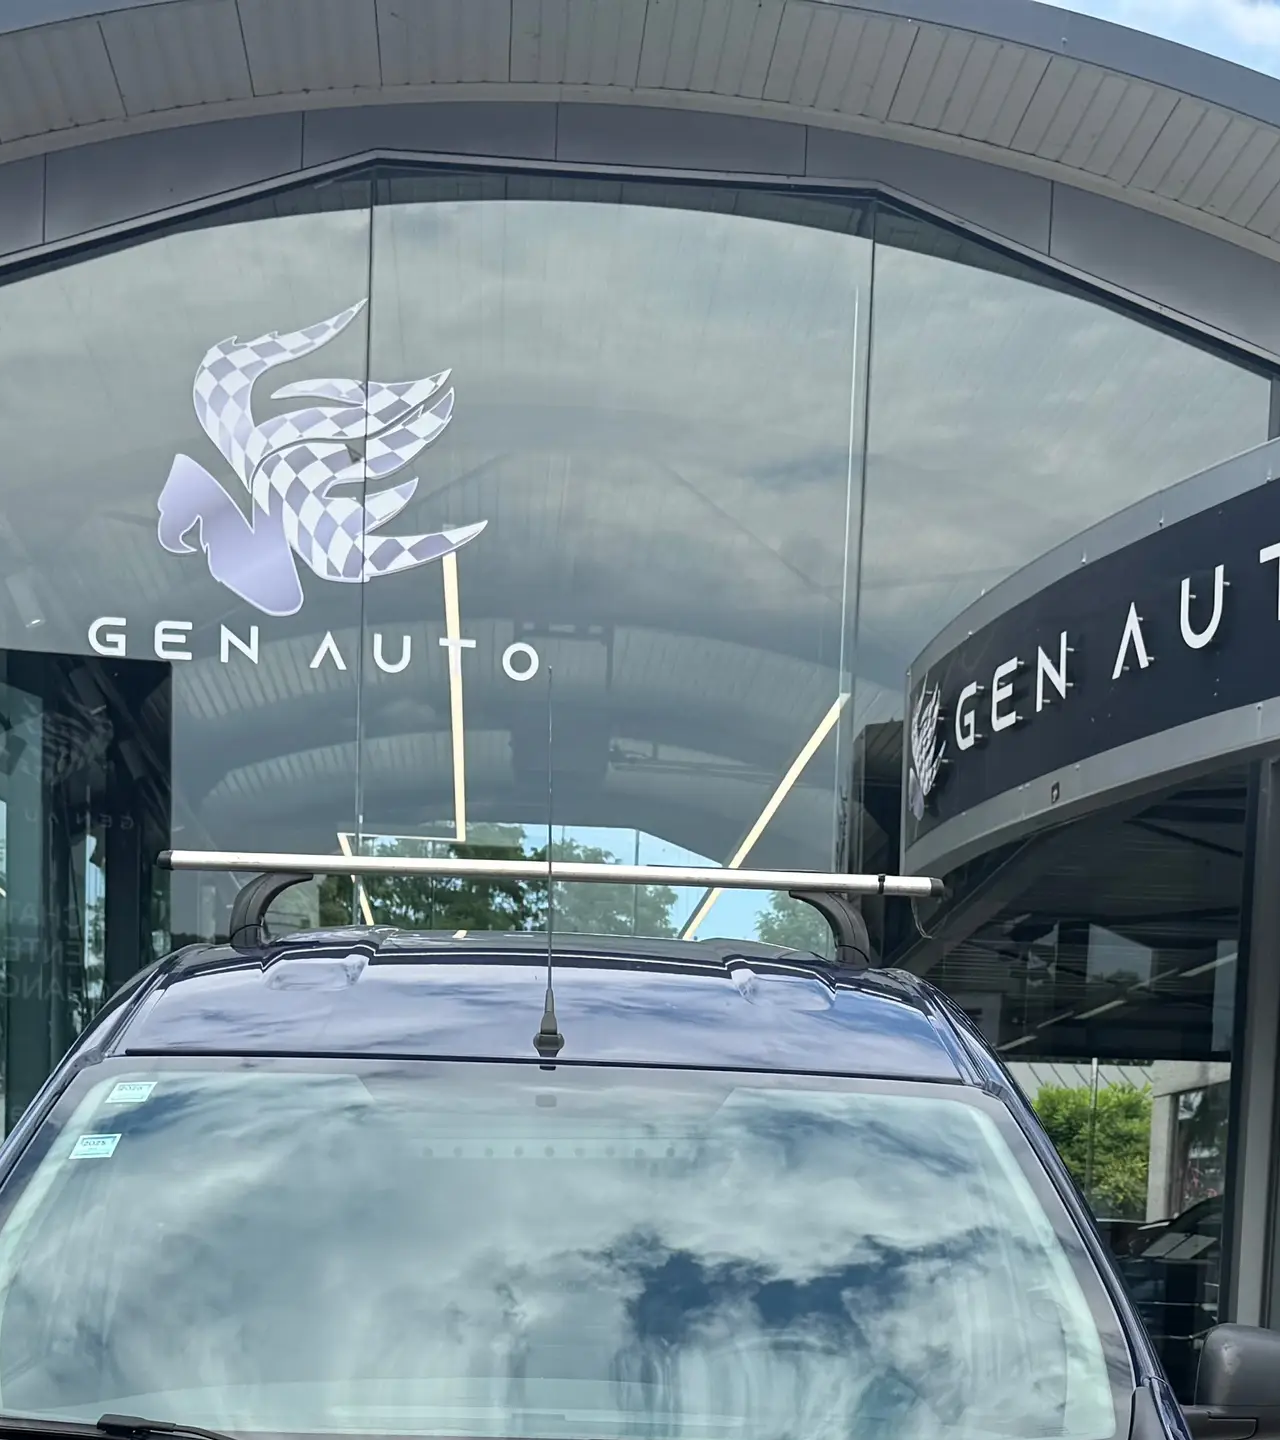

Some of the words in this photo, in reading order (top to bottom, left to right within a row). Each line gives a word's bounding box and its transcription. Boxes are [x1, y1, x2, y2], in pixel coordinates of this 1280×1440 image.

[87, 616, 259, 665] GEN
[309, 631, 540, 681] AUTO
[954, 631, 1068, 751] GEN
